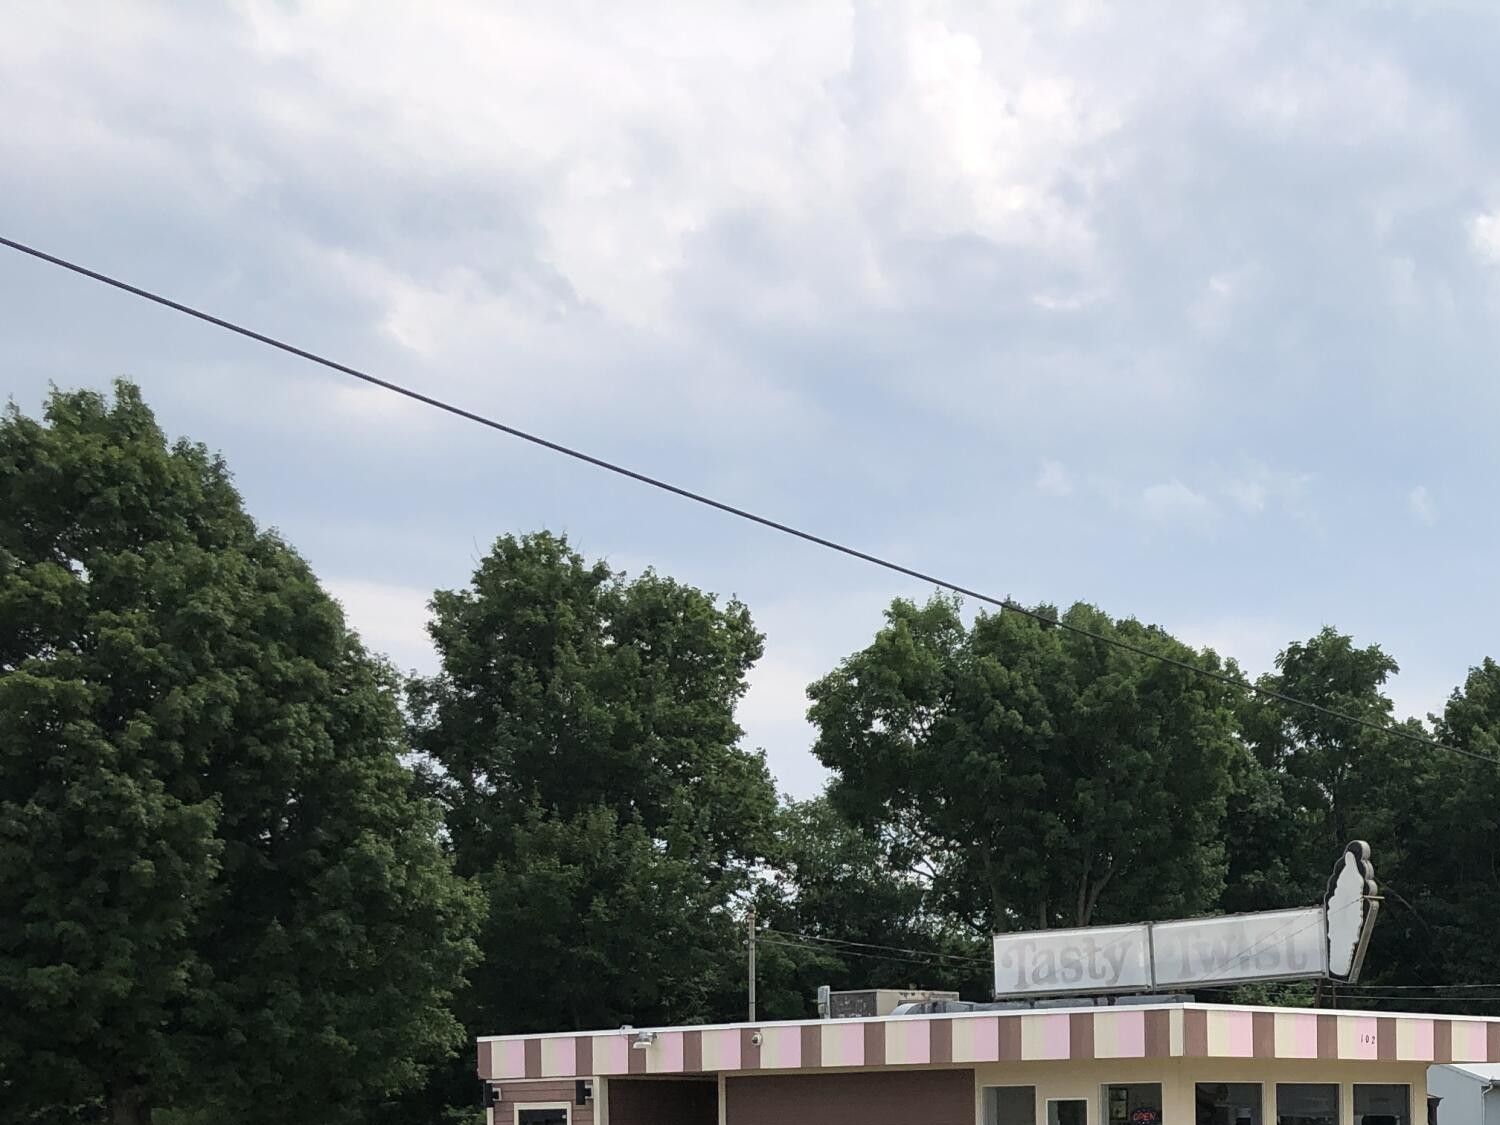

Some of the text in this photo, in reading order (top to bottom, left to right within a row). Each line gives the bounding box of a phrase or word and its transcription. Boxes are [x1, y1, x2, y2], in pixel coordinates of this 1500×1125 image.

[1002, 937, 1133, 989] Tasty
[1360, 1033, 1376, 1045] 102
[1132, 1111, 1156, 1121] OPEN
